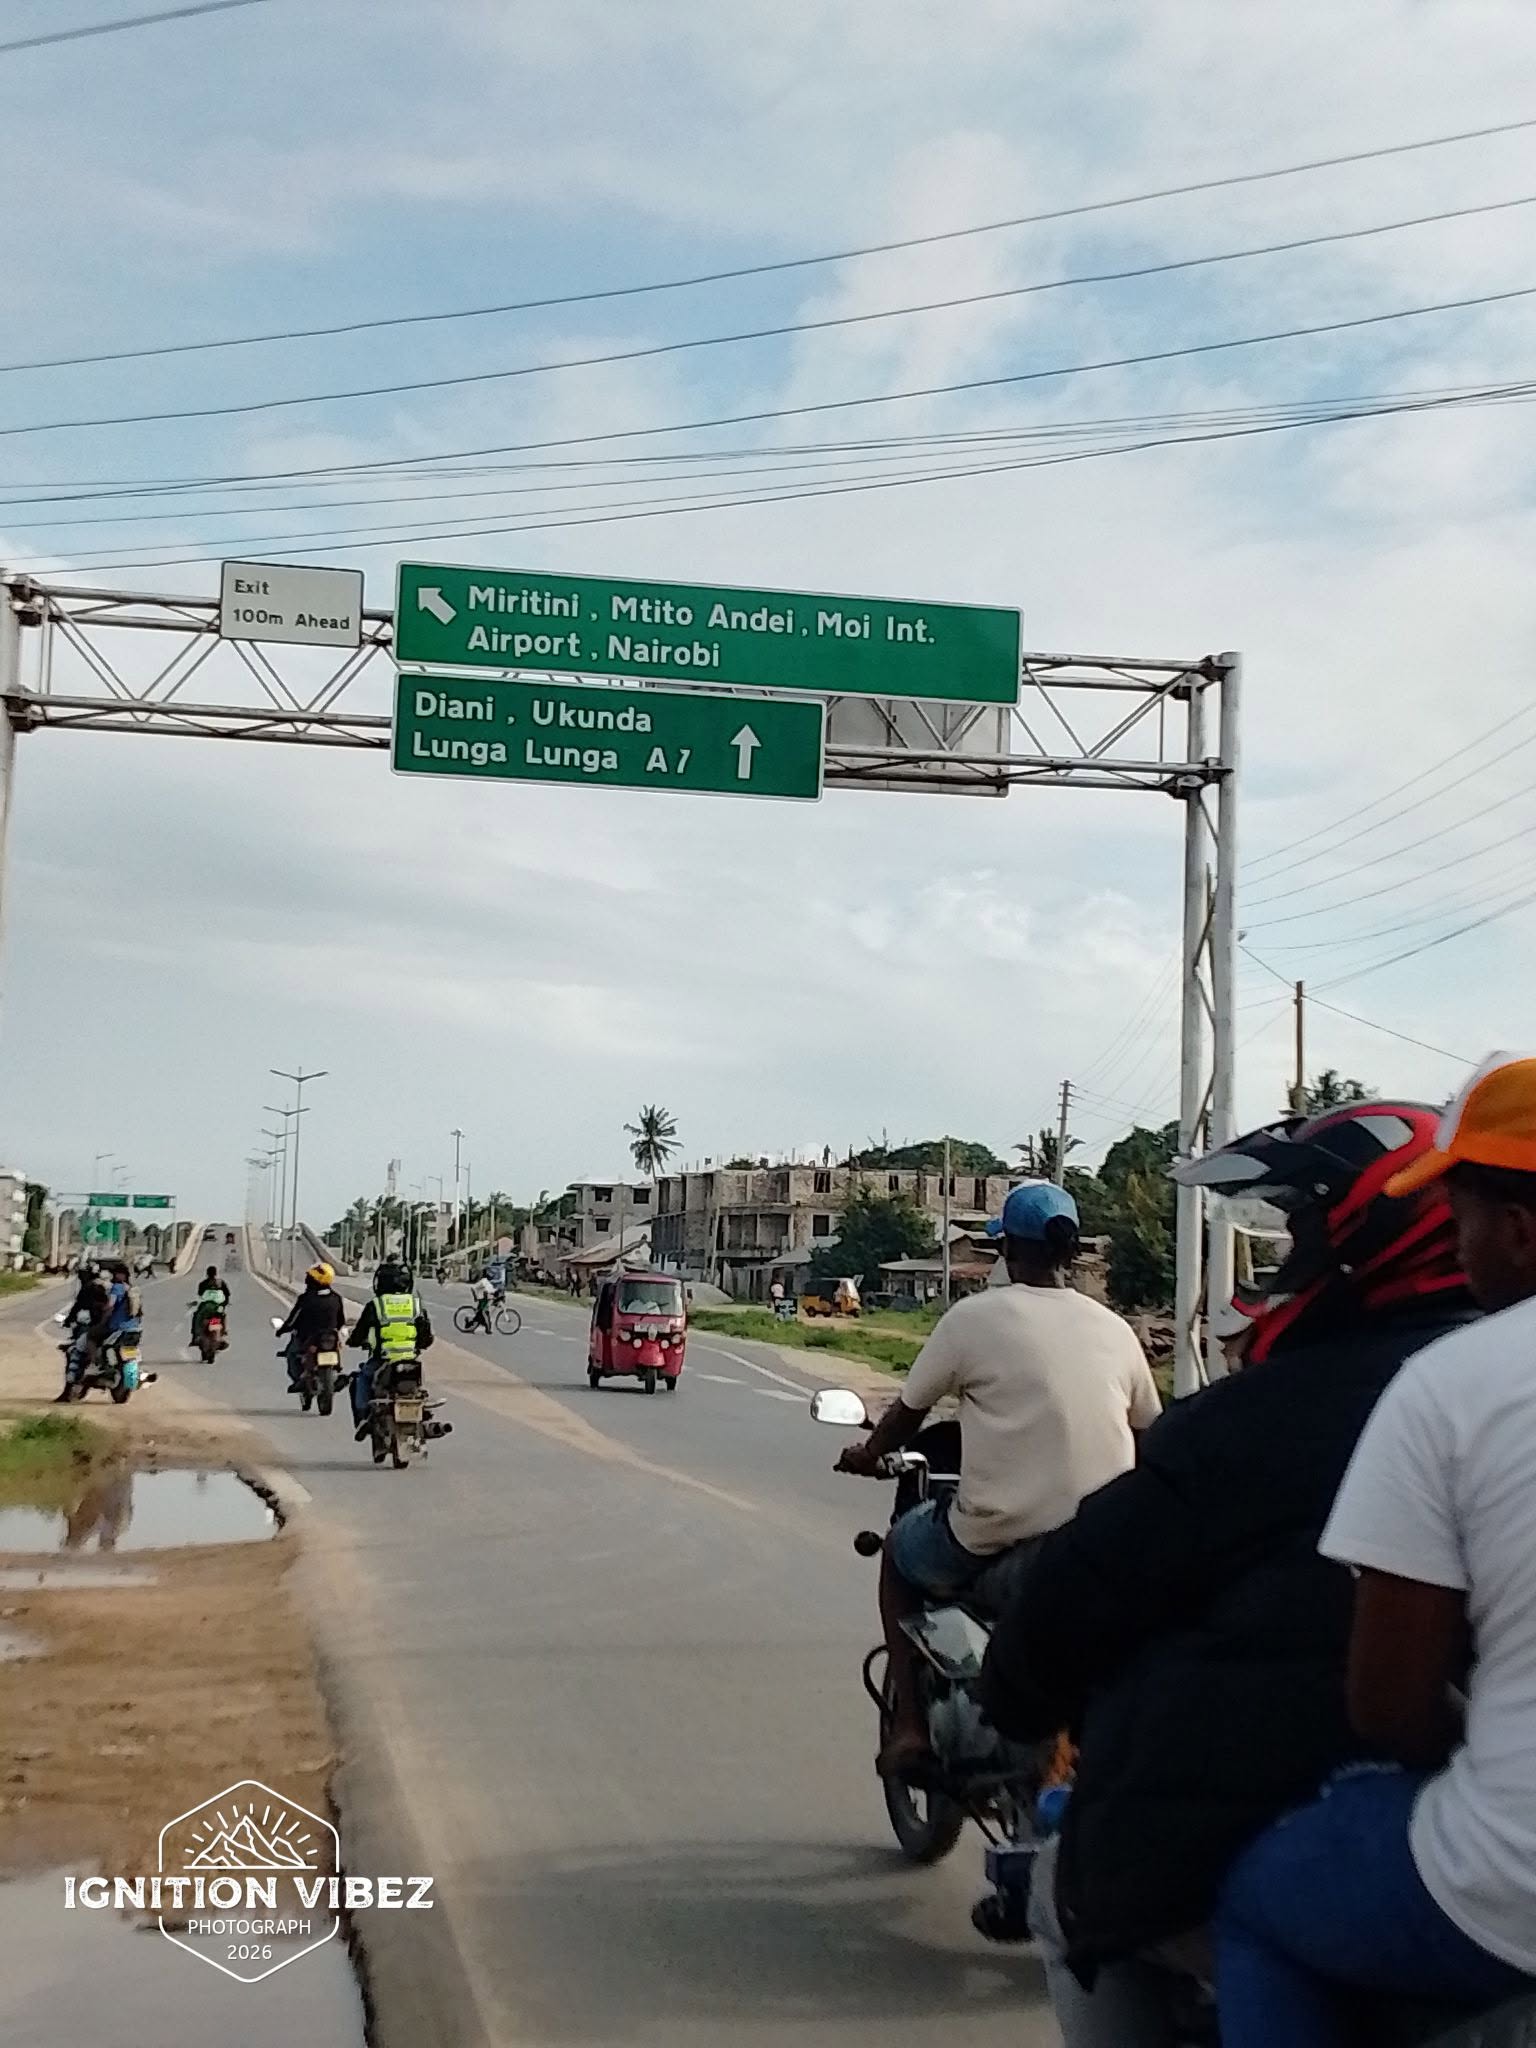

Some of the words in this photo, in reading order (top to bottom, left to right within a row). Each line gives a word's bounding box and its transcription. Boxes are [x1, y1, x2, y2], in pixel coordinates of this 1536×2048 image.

[234, 579, 270, 597] Exit
[233, 608, 284, 625] 100m
[294, 613, 350, 631] Ahead
[611, 595, 694, 627] Mtito
[817, 611, 871, 639] Moi
[886, 615, 936, 644] Int.
[608, 635, 720, 667] Nairobi
[532, 700, 652, 732] Ukunda
[412, 731, 508, 765] Lunga
[525, 739, 618, 773] Lunga
